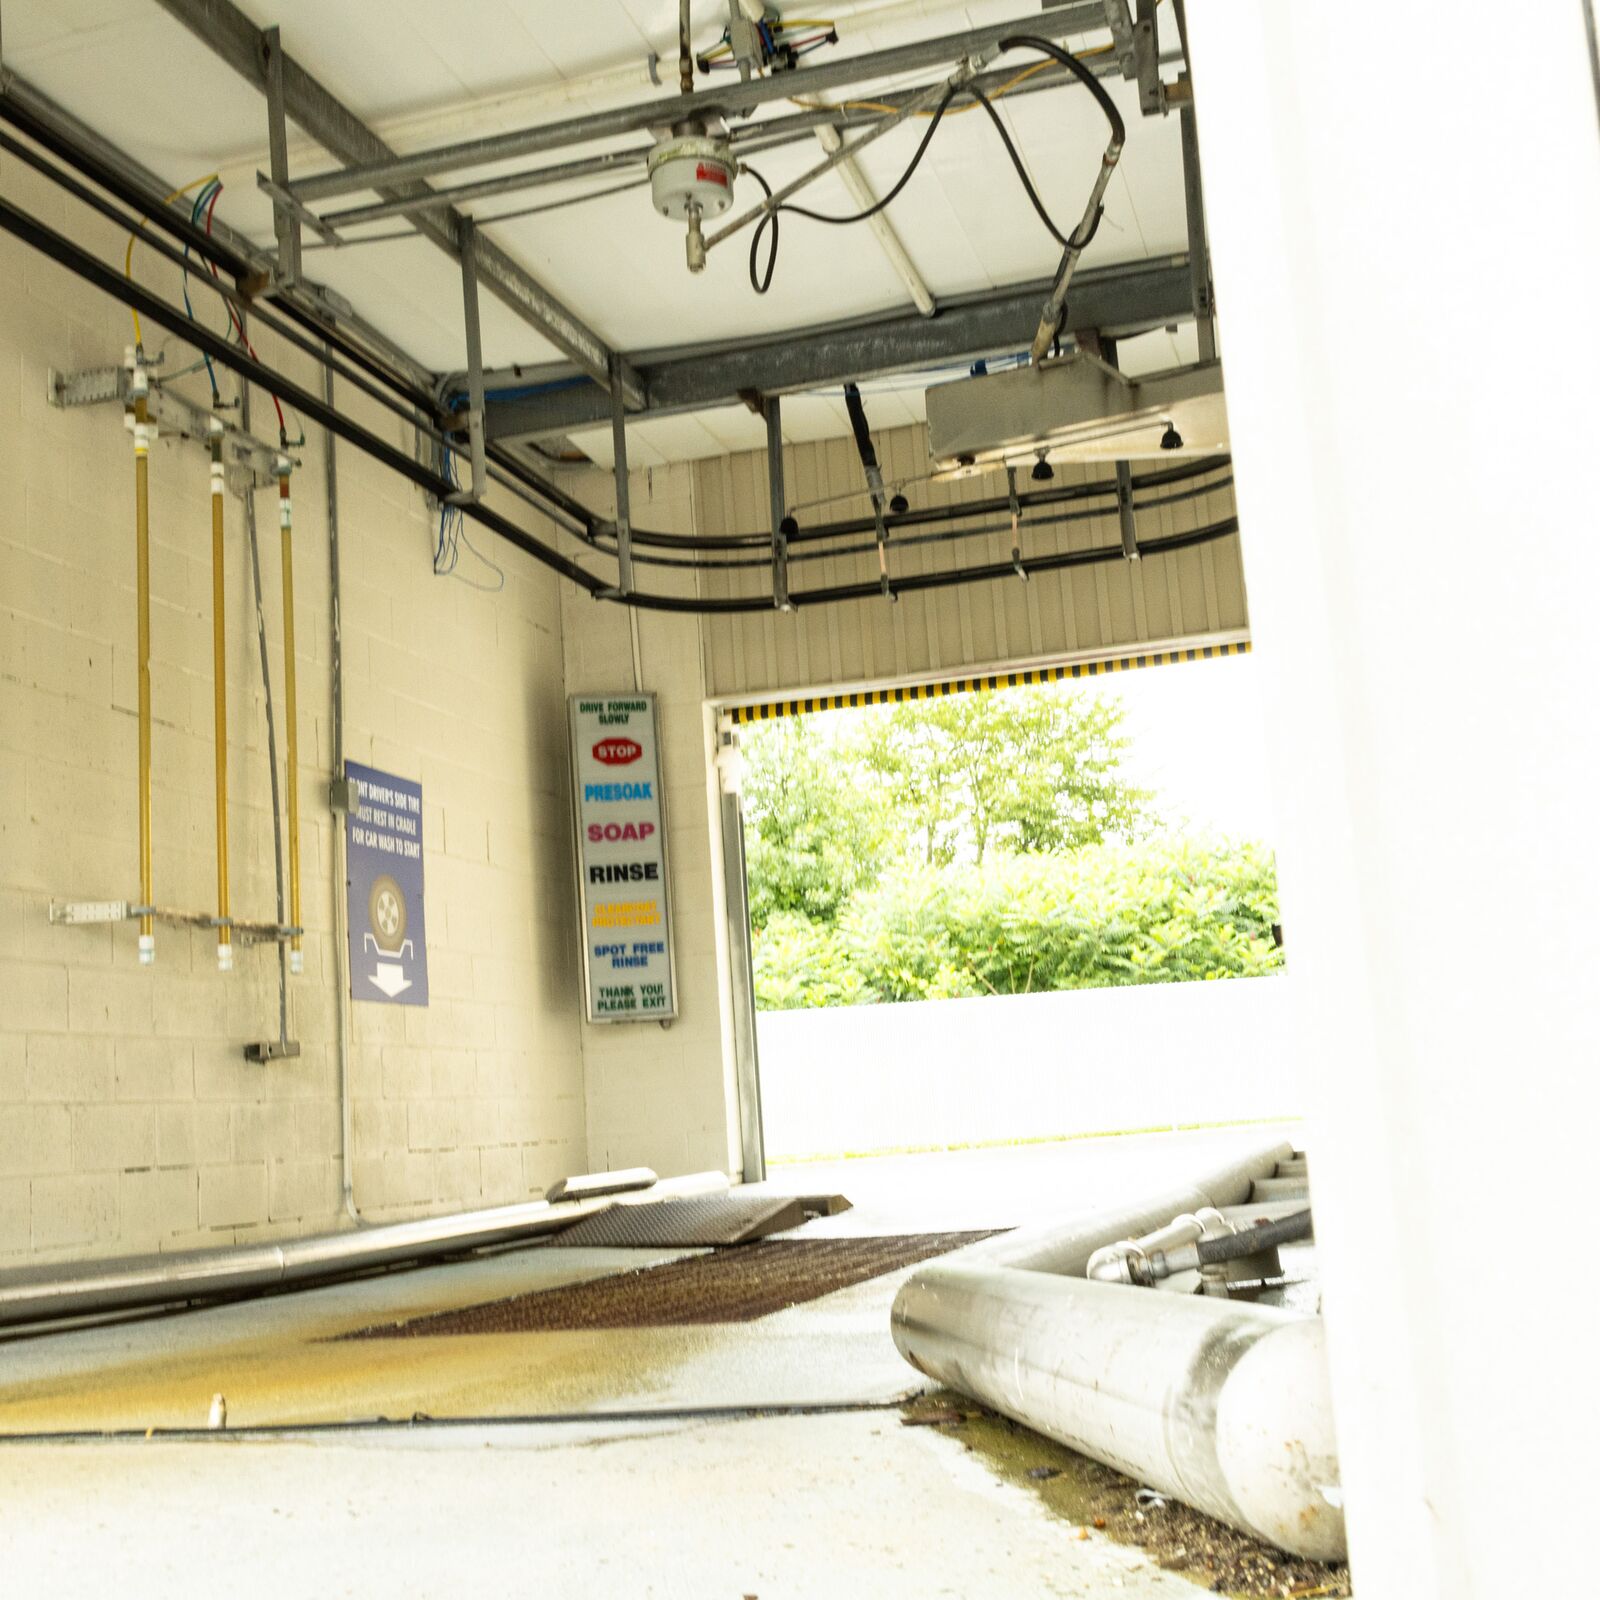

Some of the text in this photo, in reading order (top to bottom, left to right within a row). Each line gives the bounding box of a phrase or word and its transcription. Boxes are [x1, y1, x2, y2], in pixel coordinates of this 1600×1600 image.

[580, 701, 647, 713] DRIVE FORWARD
[599, 713, 629, 725] SLOWLY
[598, 744, 637, 758] STOP
[585, 782, 652, 802] PRESOAK
[395, 791, 407, 811] SIDE
[408, 794, 420, 814] TIRE
[373, 807, 387, 827] REST
[388, 812, 395, 829] IN
[395, 814, 416, 836] CRADLE
[588, 822, 655, 842] SOAP
[352, 825, 420, 859] FOR CAR WASH TO START
[590, 862, 659, 883] RINSE
[594, 942, 664, 957] SPOT FREE
[612, 956, 648, 968] RINSE
[599, 983, 663, 998] THANK YOU!
[597, 996, 665, 1011] PLEASE EXIT
